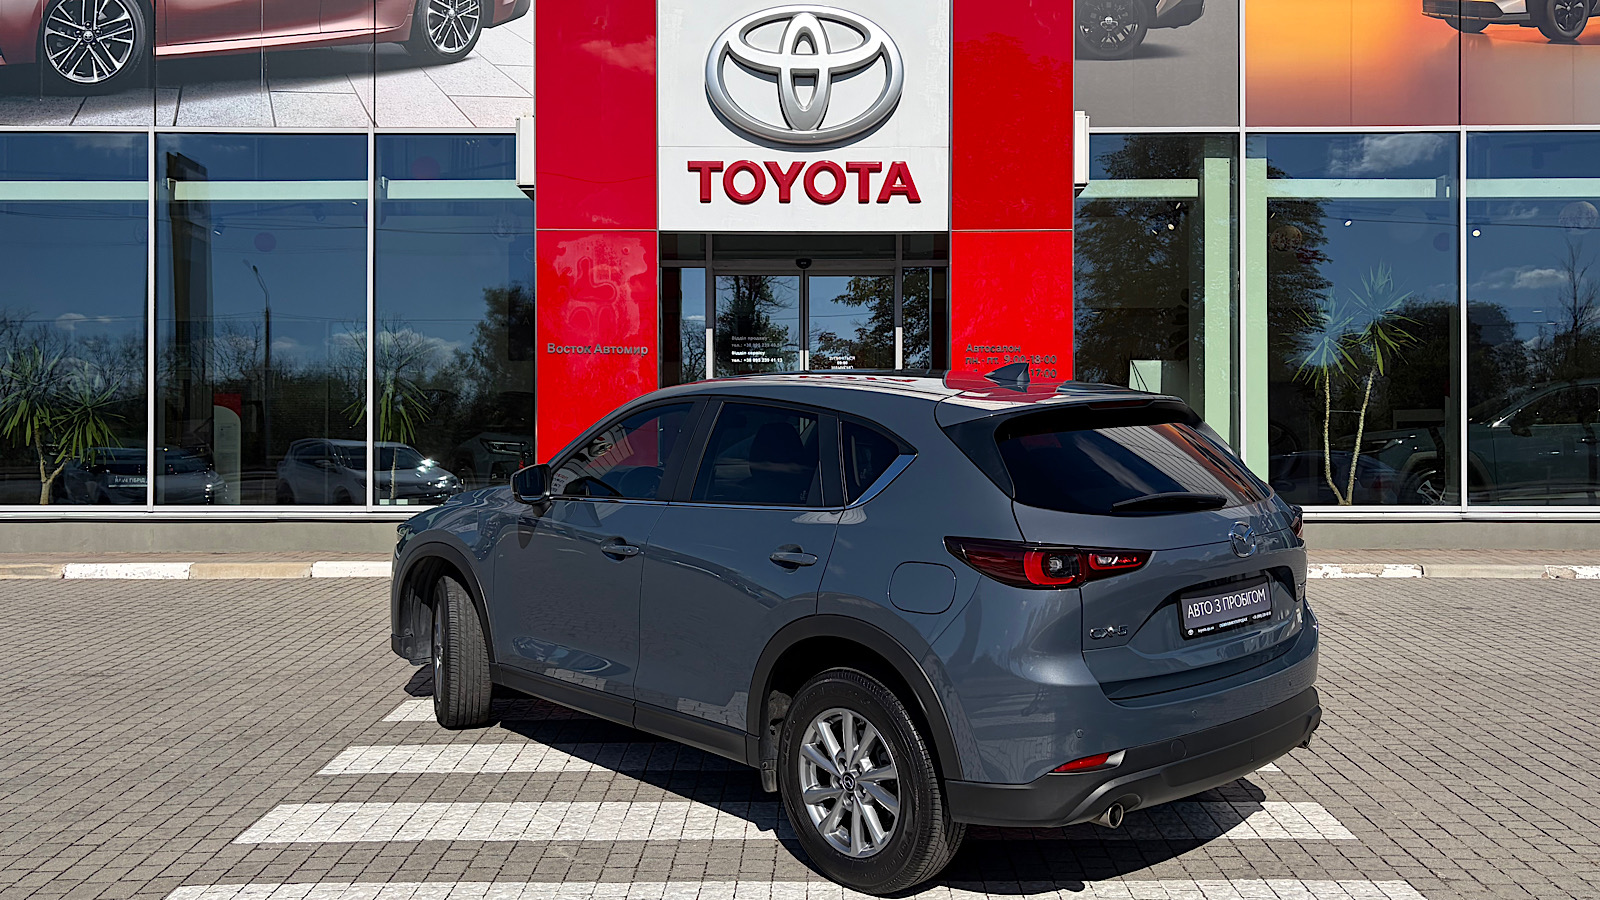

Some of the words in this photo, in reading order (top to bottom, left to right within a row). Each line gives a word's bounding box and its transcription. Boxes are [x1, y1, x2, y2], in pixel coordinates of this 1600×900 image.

[687, 159, 922, 205] TOYOTA
[547, 342, 592, 354] Восток
[593, 343, 649, 358] Автомир
[966, 343, 1021, 353] Автосалон
[1187, 600, 1213, 619] АВТО
[1222, 588, 1266, 611] ПРОБІГОМ
[1089, 624, 1129, 639] CX-5
